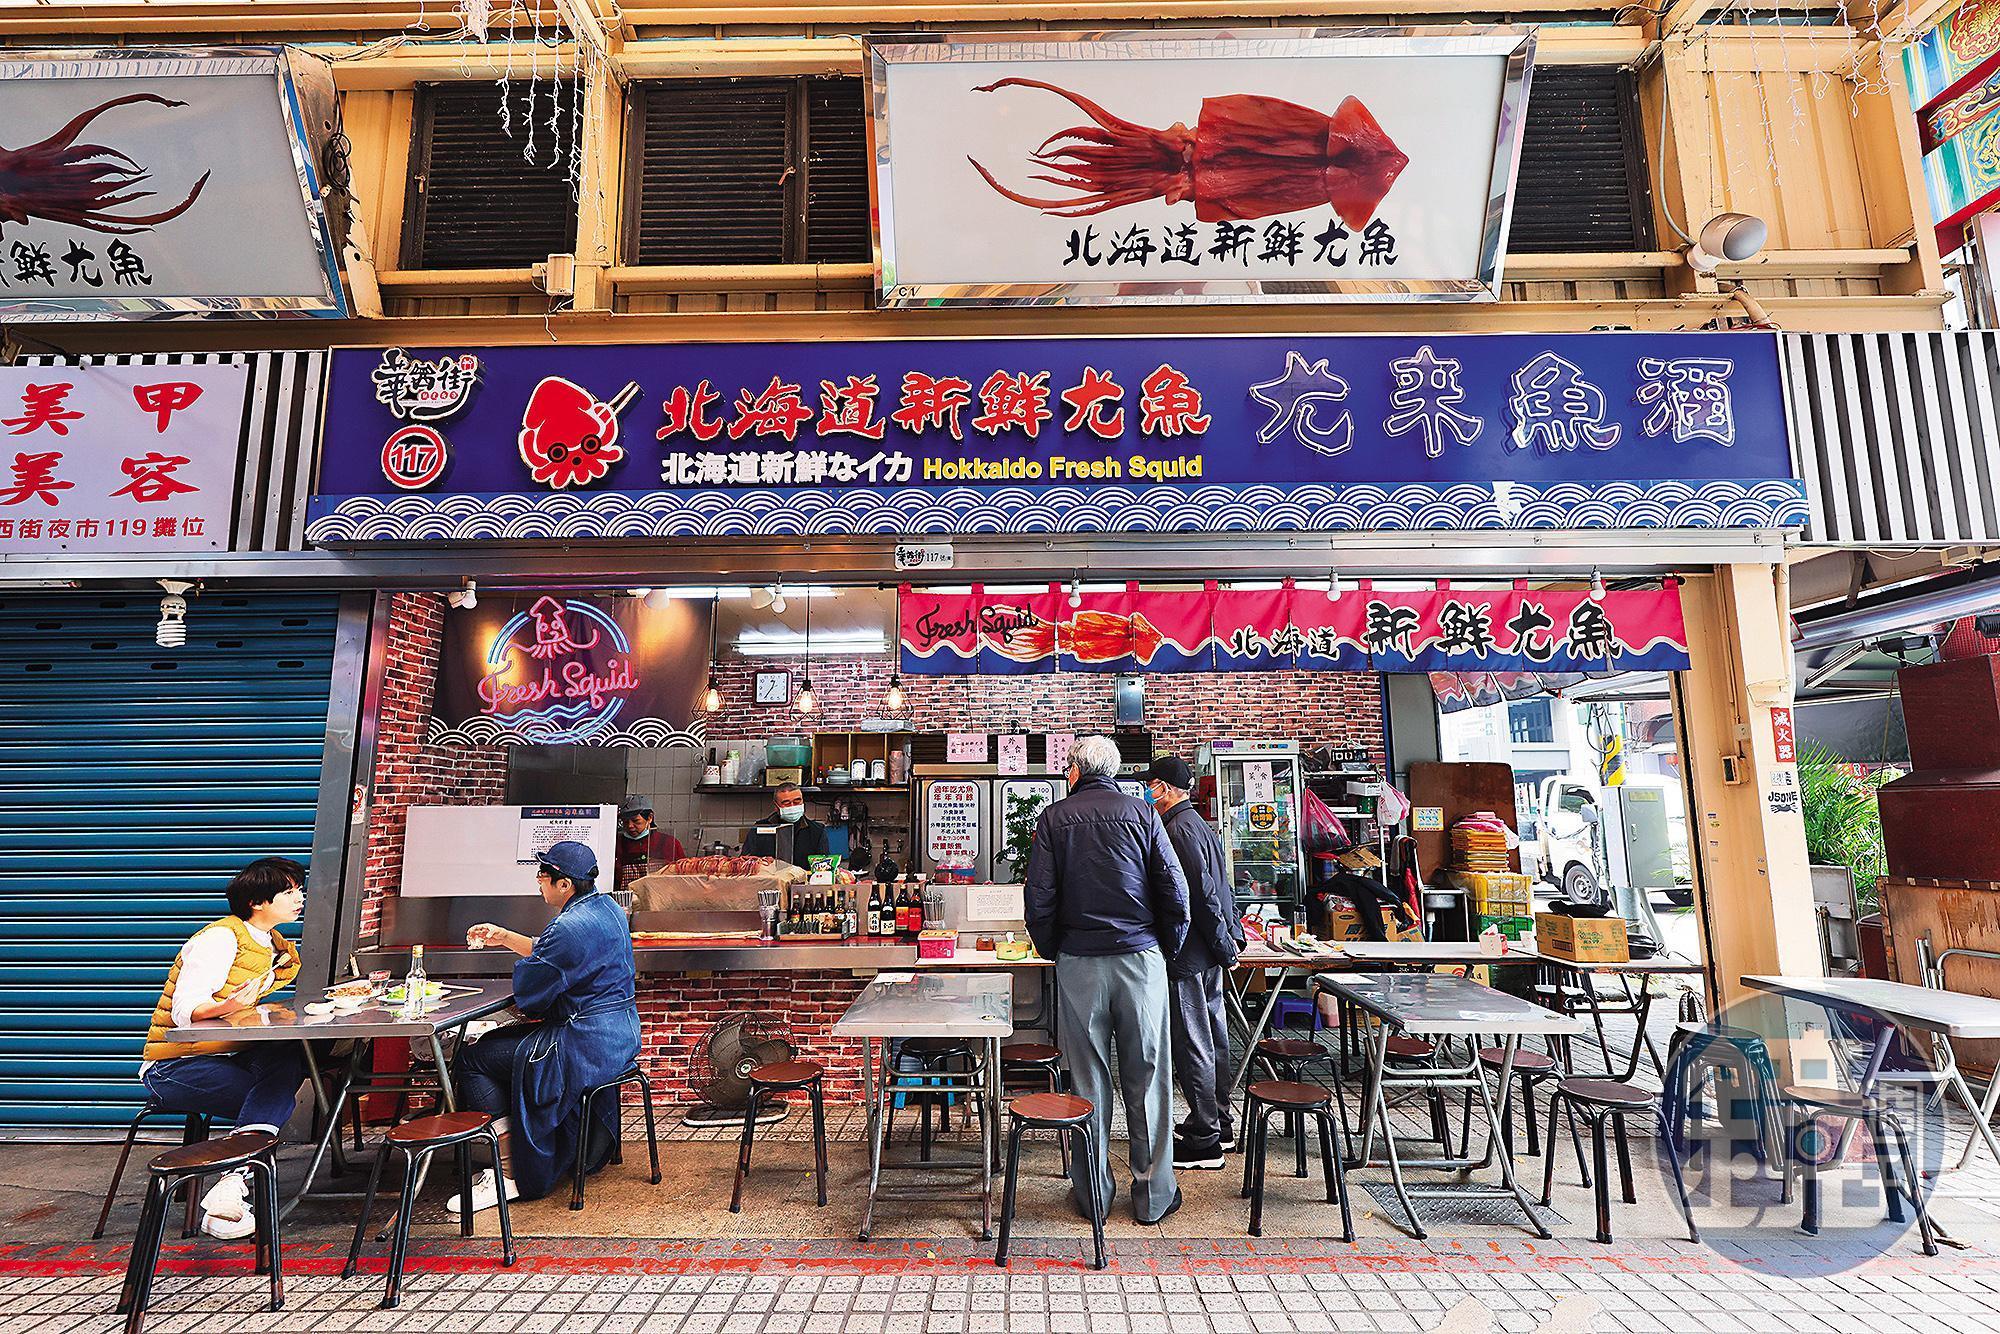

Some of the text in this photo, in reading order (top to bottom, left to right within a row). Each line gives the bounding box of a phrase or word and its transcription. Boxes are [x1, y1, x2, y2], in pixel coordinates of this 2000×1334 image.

[0, 236, 153, 288] 鮮尤魚
[1063, 219, 1398, 269] 北海道新鮮尤魚
[656, 362, 1212, 442] 北海道新鮮尤魚
[391, 444, 438, 473] 117
[661, 451, 913, 485] 北海道新鮮なイカ
[923, 455, 1203, 481] Hokkaido Fresh Squid
[916, 603, 1039, 647] Fresh Squid
[477, 658, 640, 714] Fresh Squid
[1773, 711, 1794, 760] 滅火器
